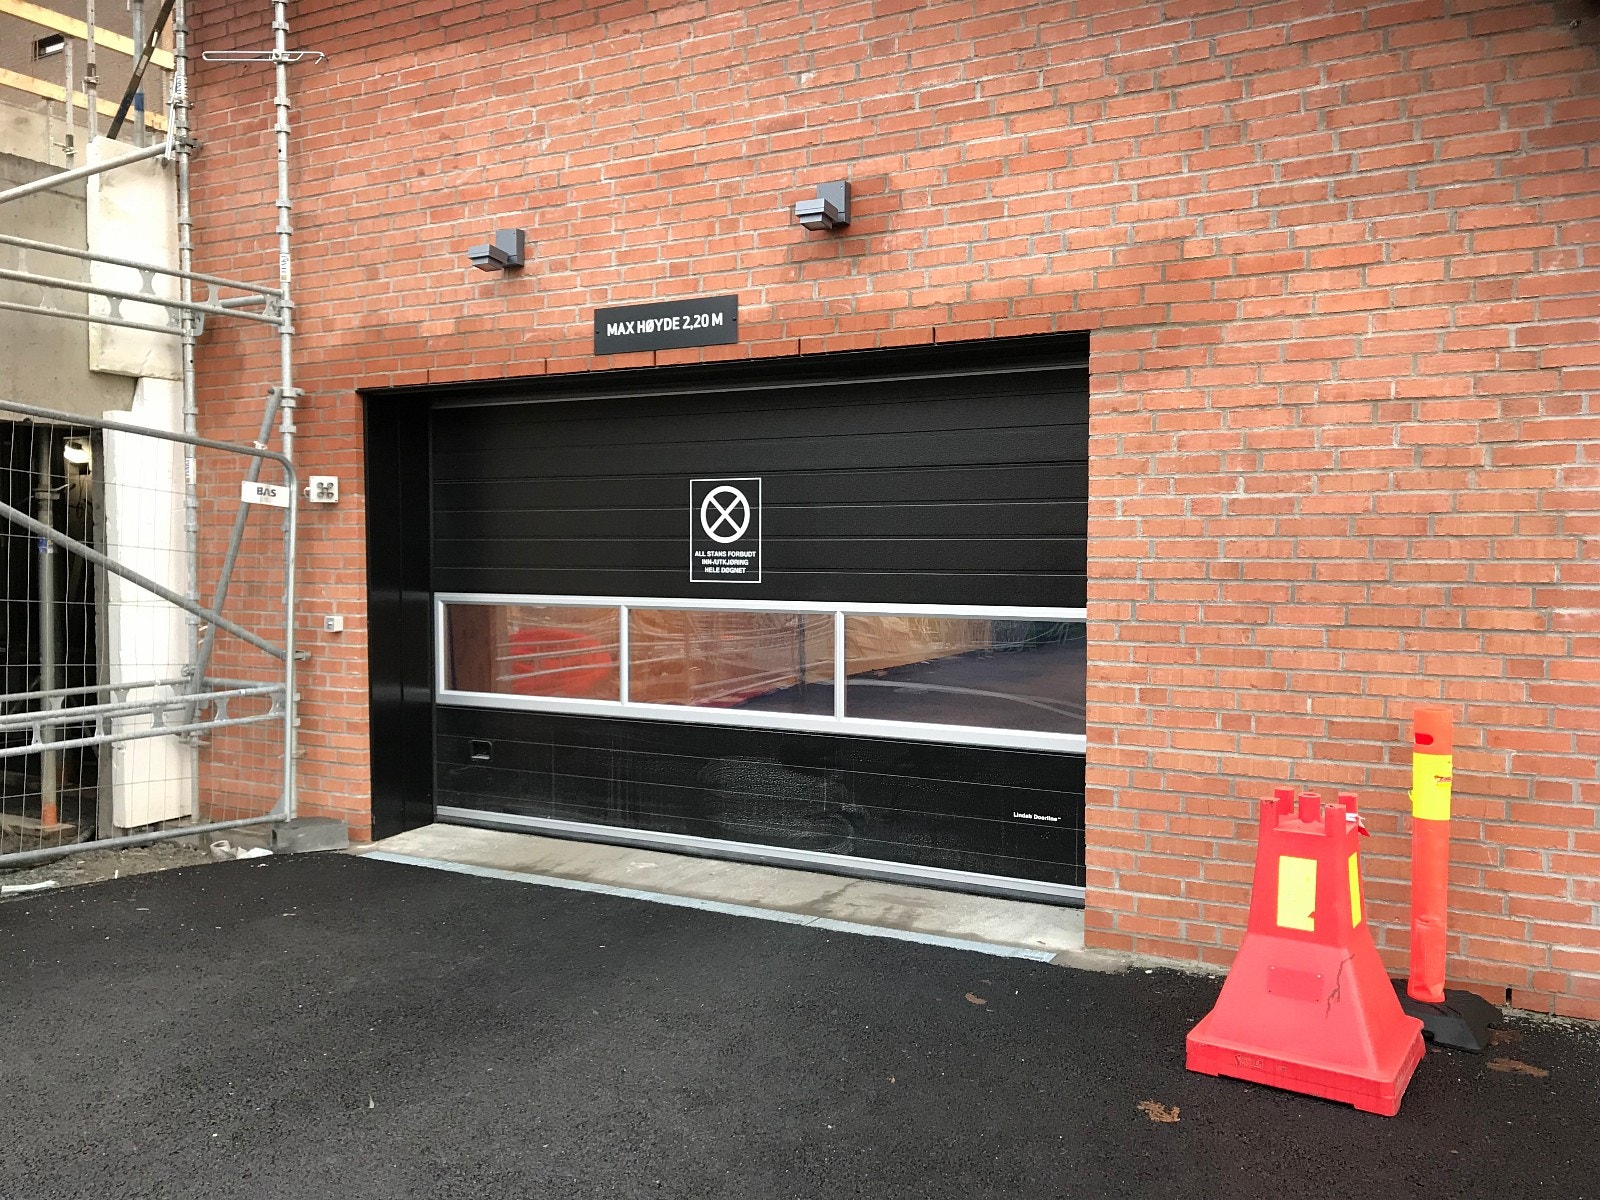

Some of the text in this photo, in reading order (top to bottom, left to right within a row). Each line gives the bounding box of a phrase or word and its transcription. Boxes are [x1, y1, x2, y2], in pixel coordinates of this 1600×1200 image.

[606, 312, 723, 337] MAX HØYDE 2,20 M
[256, 486, 277, 497] BAS
[706, 550, 727, 558] STANS
[704, 566, 720, 574] HELE
[1013, 811, 1033, 819] Lindab
